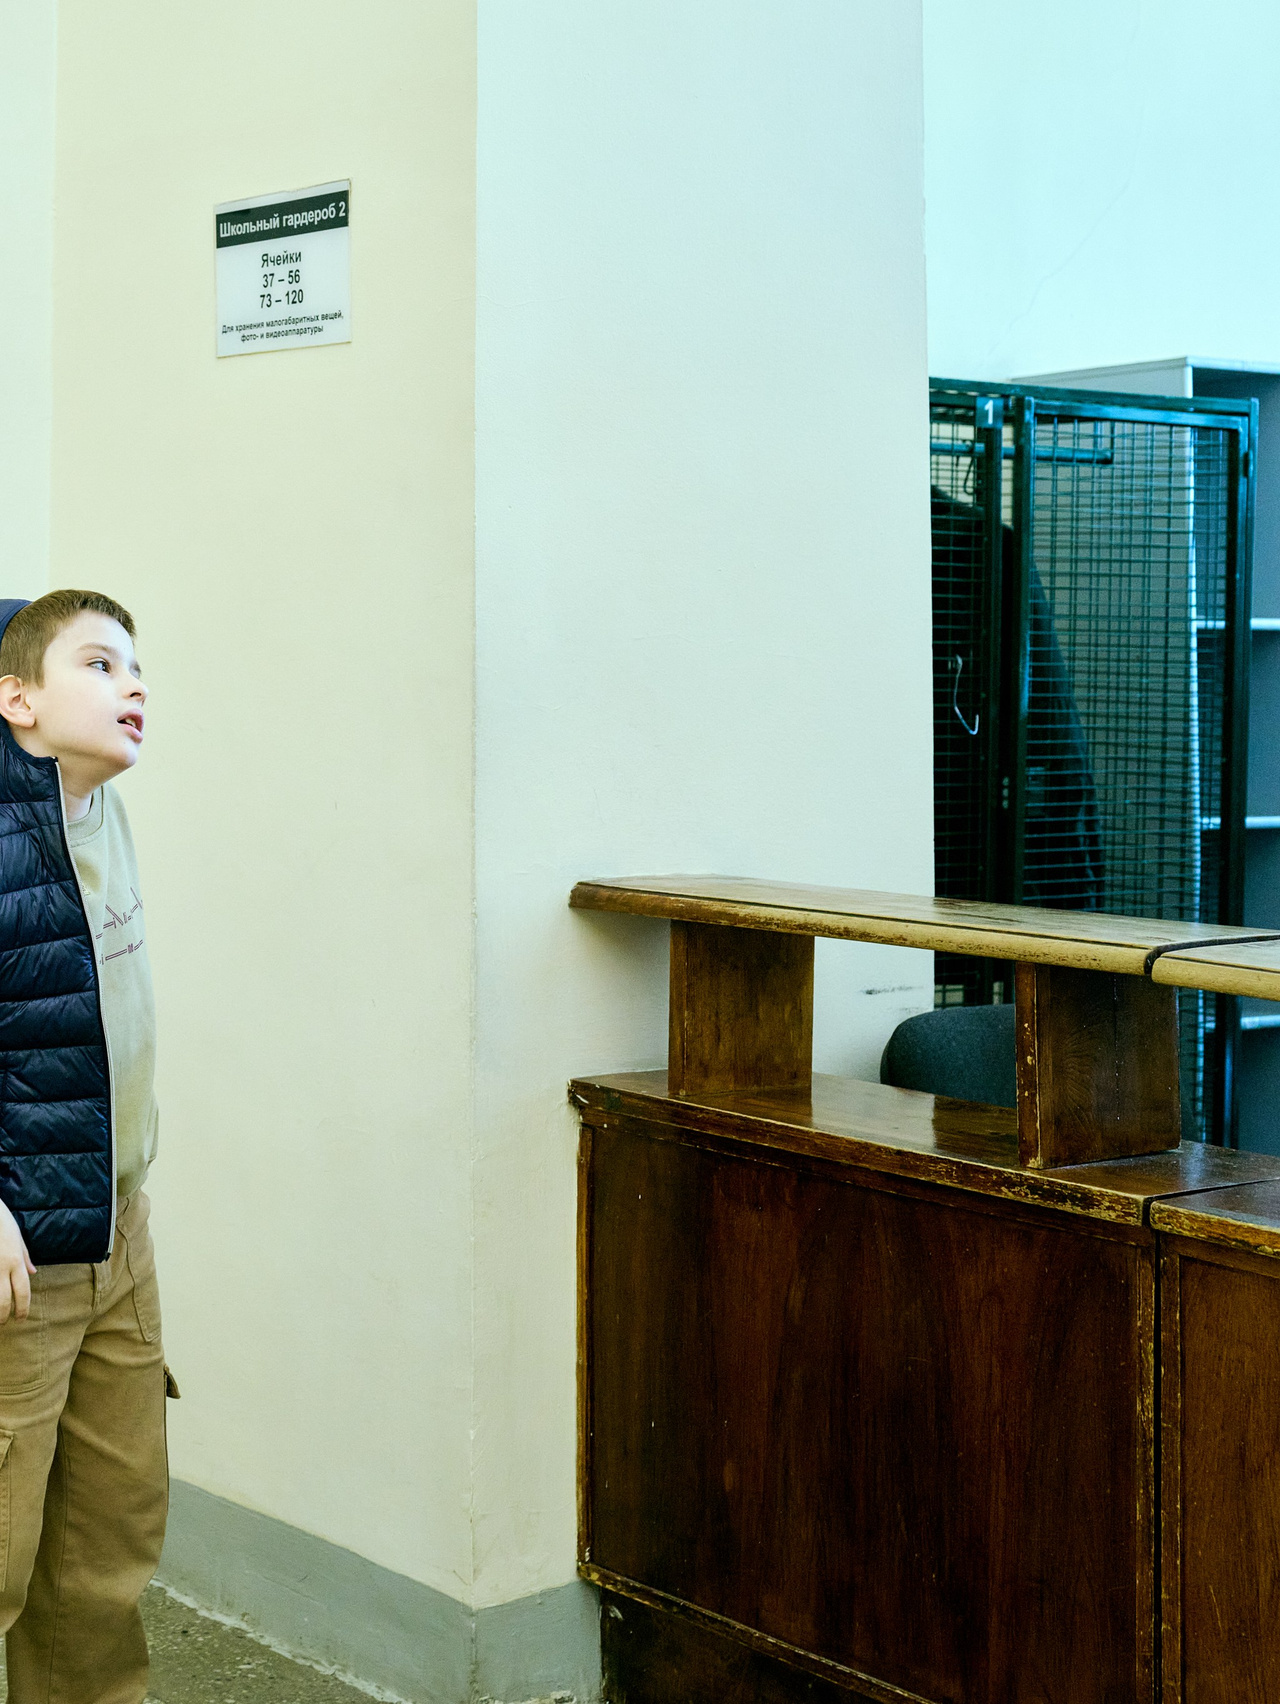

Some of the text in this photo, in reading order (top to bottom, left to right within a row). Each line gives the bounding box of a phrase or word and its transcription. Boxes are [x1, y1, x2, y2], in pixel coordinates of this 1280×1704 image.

[220, 201, 346, 238] Школьный гардероб 2
[261, 250, 302, 268] Ячейки
[262, 273, 275, 288] 37
[287, 269, 300, 285] 56
[260, 294, 272, 309] 73
[285, 289, 304, 305] 120
[221, 310, 344, 334] Для хранения малогабаритных вещей,
[241, 324, 324, 343] фото- и видеоаппаратуры
[984, 399, 993, 425] 1
